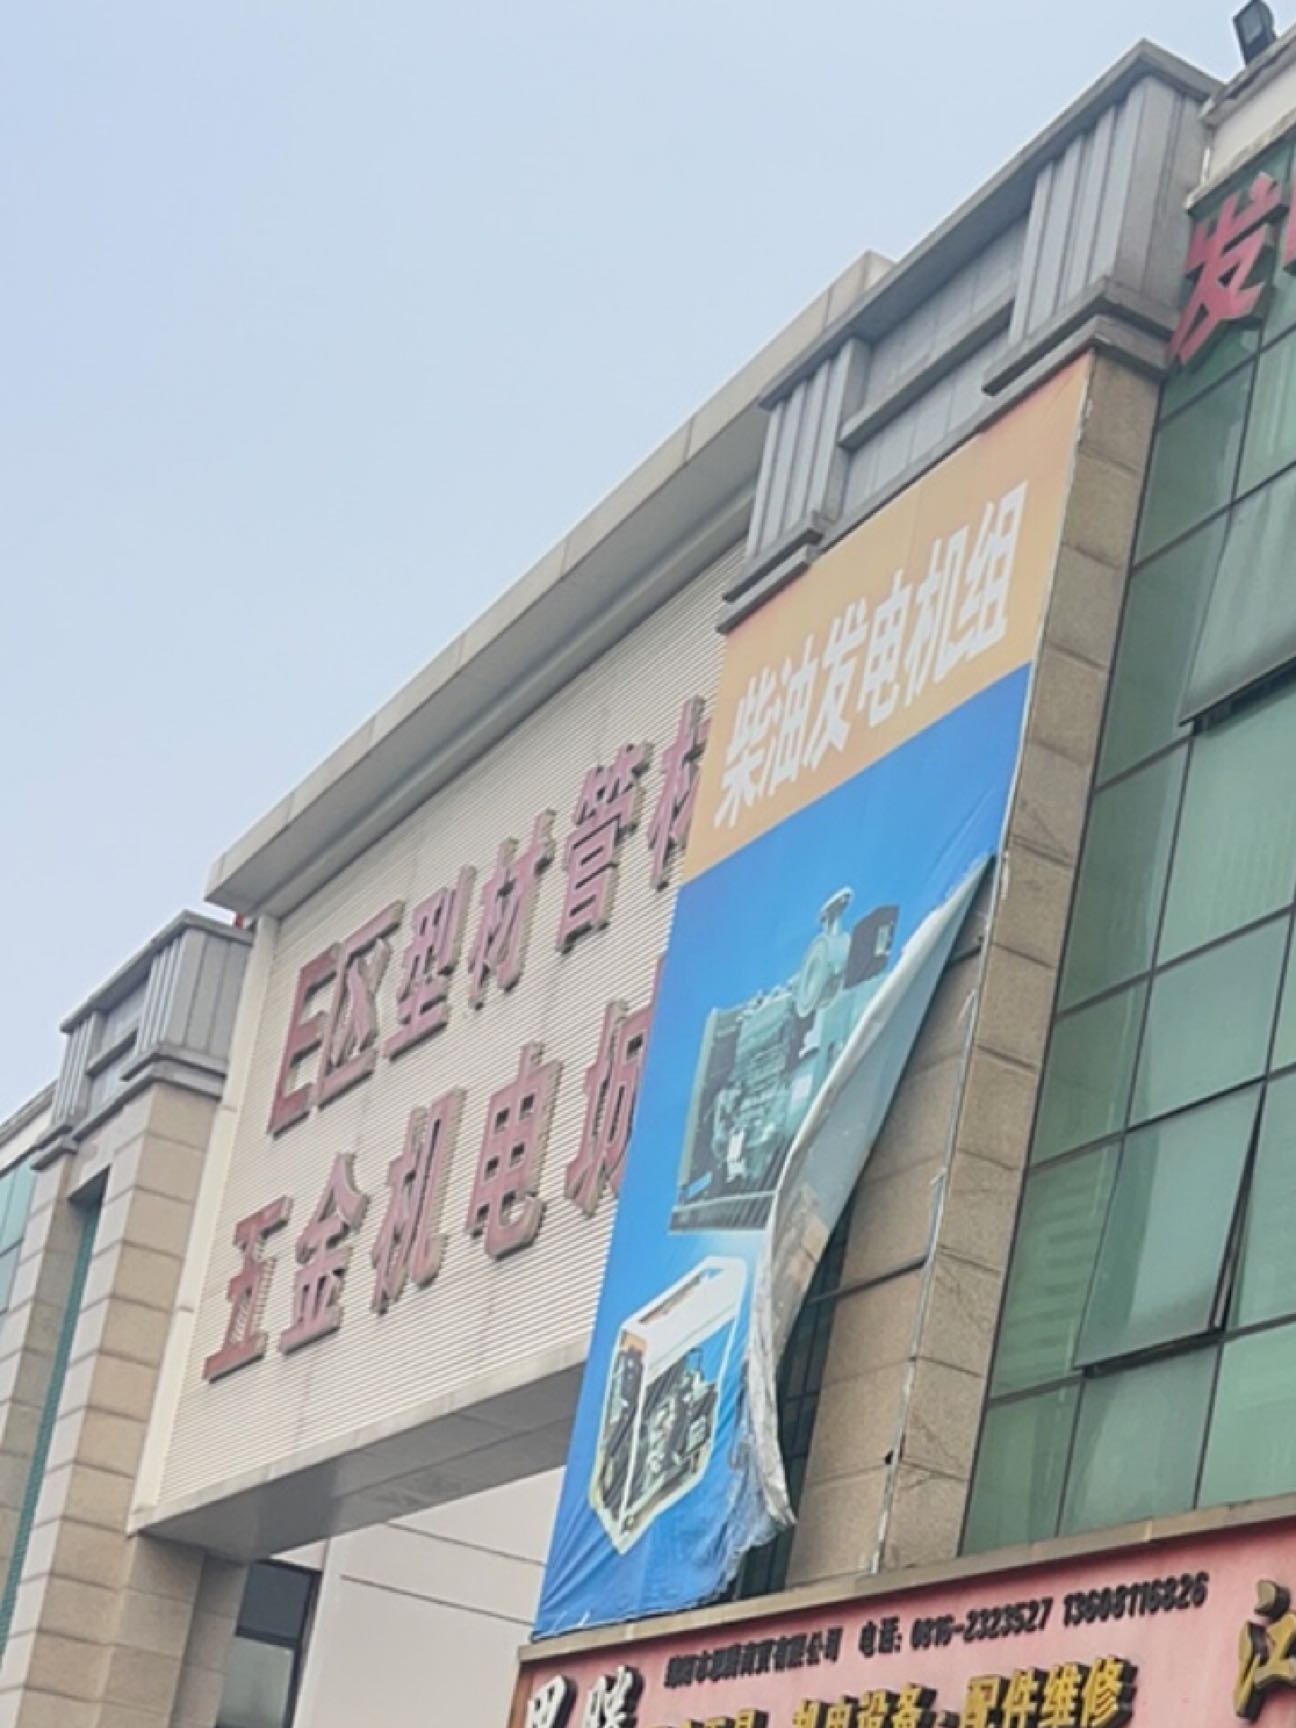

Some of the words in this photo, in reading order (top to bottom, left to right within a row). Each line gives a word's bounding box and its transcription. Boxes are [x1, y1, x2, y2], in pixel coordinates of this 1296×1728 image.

[713, 481, 1028, 828] 柴油发电机组
